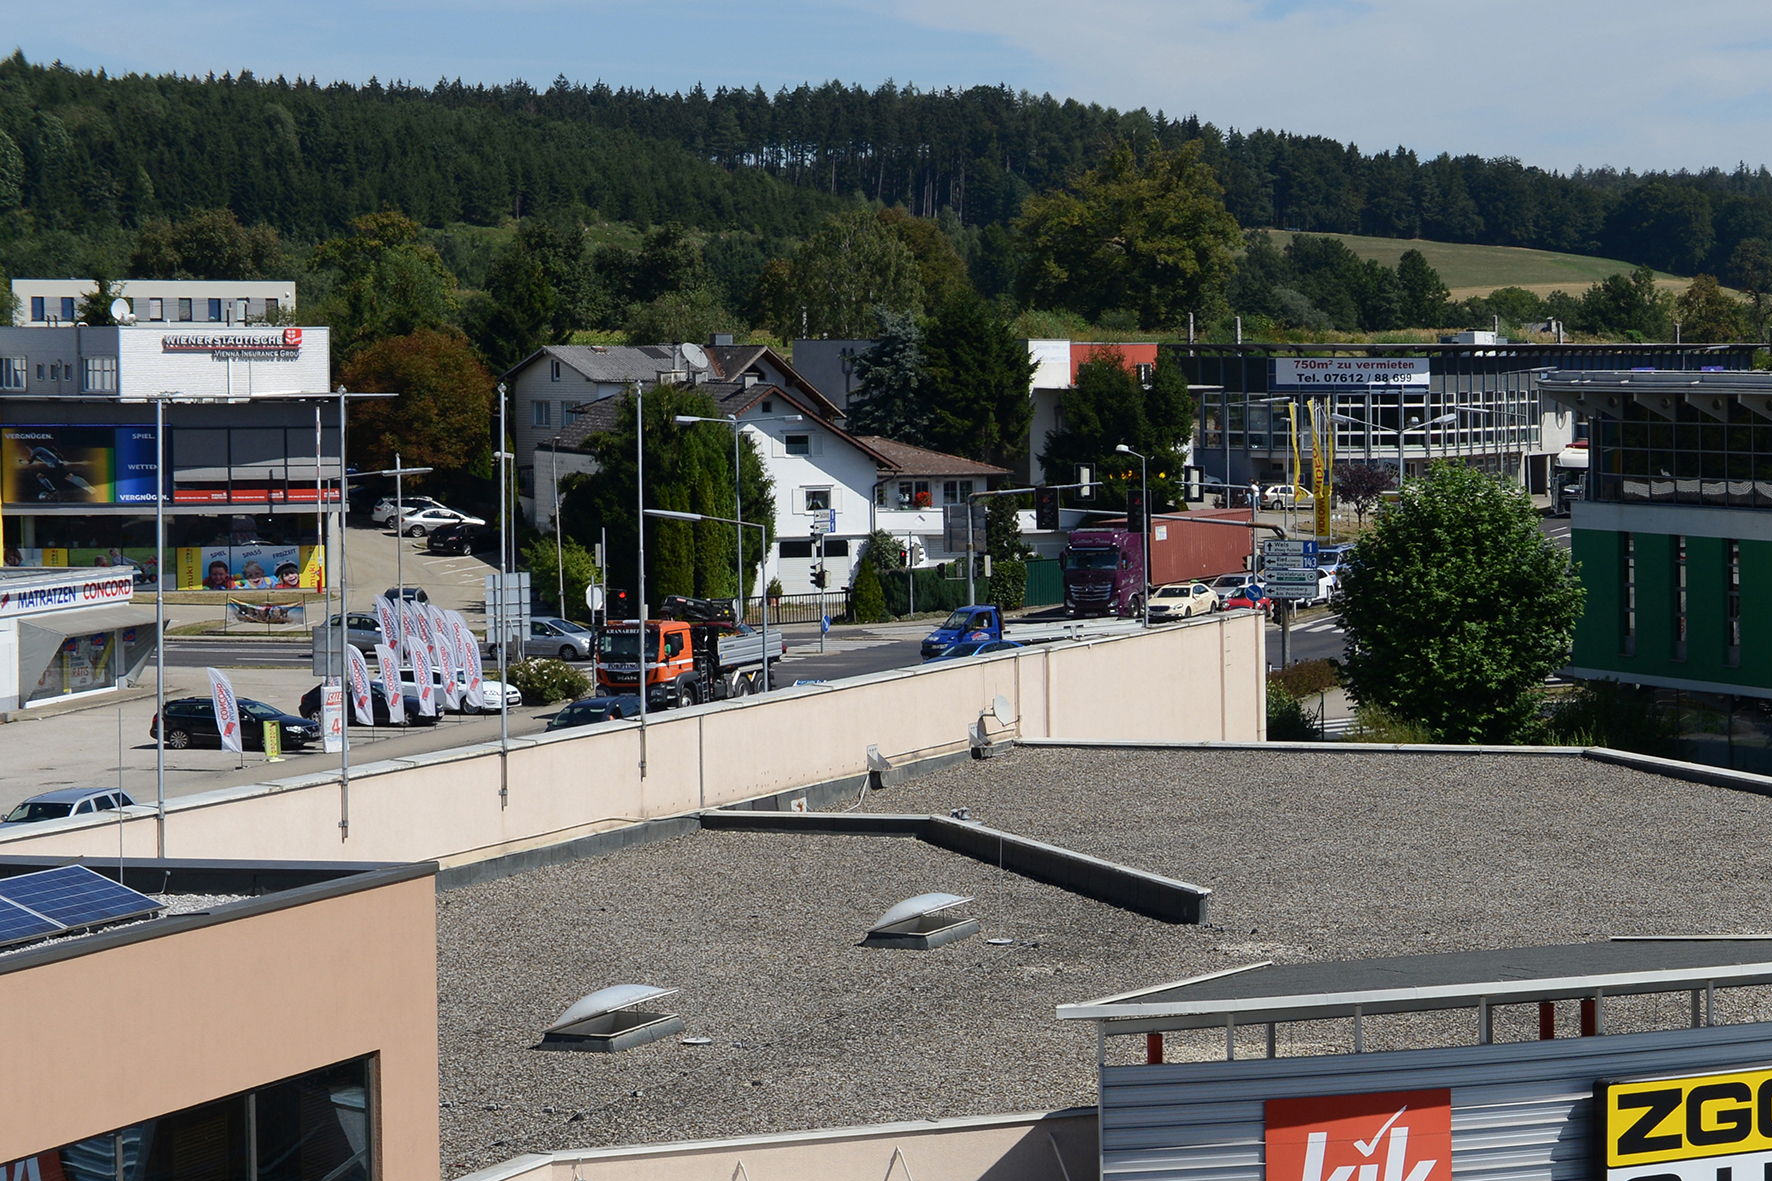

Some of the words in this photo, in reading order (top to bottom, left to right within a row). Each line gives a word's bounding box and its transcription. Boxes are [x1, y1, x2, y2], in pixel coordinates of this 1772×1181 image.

[165, 335, 214, 345] WIENER
[1294, 359, 1334, 369] 750m²
[1337, 361, 1352, 369] zu
[1356, 360, 1415, 369] vermieten
[1297, 373, 1320, 383] Tel.
[1324, 373, 1364, 383] 07612
[1374, 373, 1389, 383] 88
[1392, 373, 1412, 383] 699
[119, 493, 170, 501] VERGNÜGN.
[1307, 542, 1313, 552] 1
[210, 551, 227, 559] SPIEL
[242, 549, 262, 559] SPASS
[272, 548, 297, 559] FREIZEIT
[1303, 557, 1317, 567] 143
[17, 586, 76, 609] MATRATZEN
[83, 579, 132, 600] CONCORD
